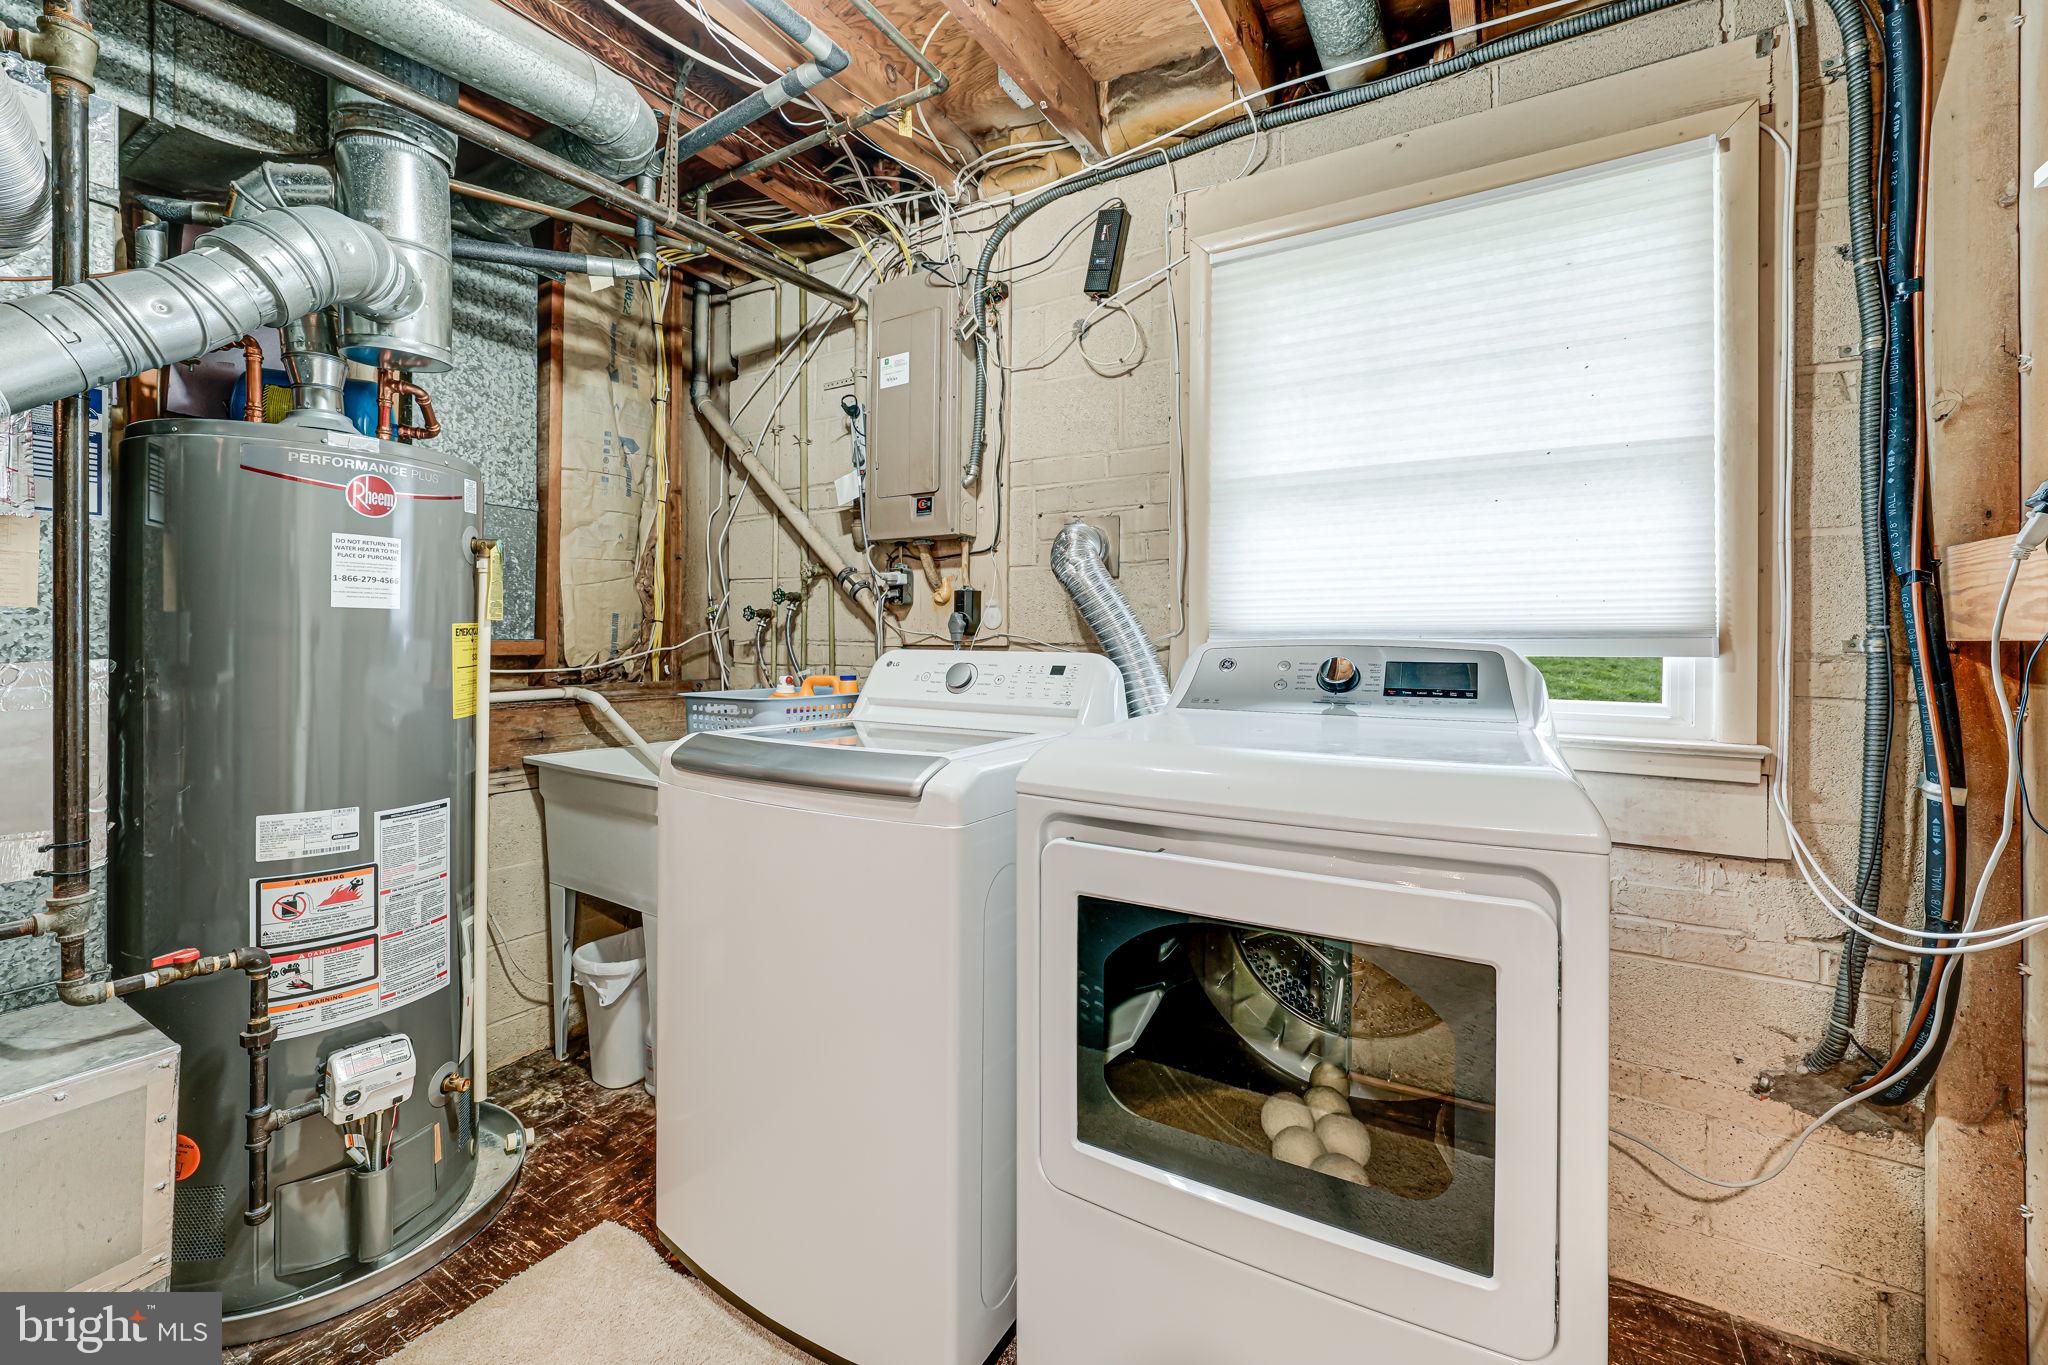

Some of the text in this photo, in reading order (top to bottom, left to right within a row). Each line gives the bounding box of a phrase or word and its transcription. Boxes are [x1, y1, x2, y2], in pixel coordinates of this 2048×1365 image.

[1893, 65, 1903, 92] WALL
[1889, 406, 1898, 421] 122
[1888, 428, 1897, 440] 02
[287, 451, 440, 484] PERFORMANCE PLUS
[352, 475, 394, 510] Rheem
[1888, 492, 1896, 517] WALL
[367, 554, 398, 562] PURCHASE
[1892, 549, 1901, 560] ID
[333, 574, 400, 585] 1-866-279-4566
[303, 874, 345, 885] WARNING
[1931, 866, 1942, 892] WALL
[307, 946, 342, 958] DANGER
[307, 994, 344, 1006] WARNING
